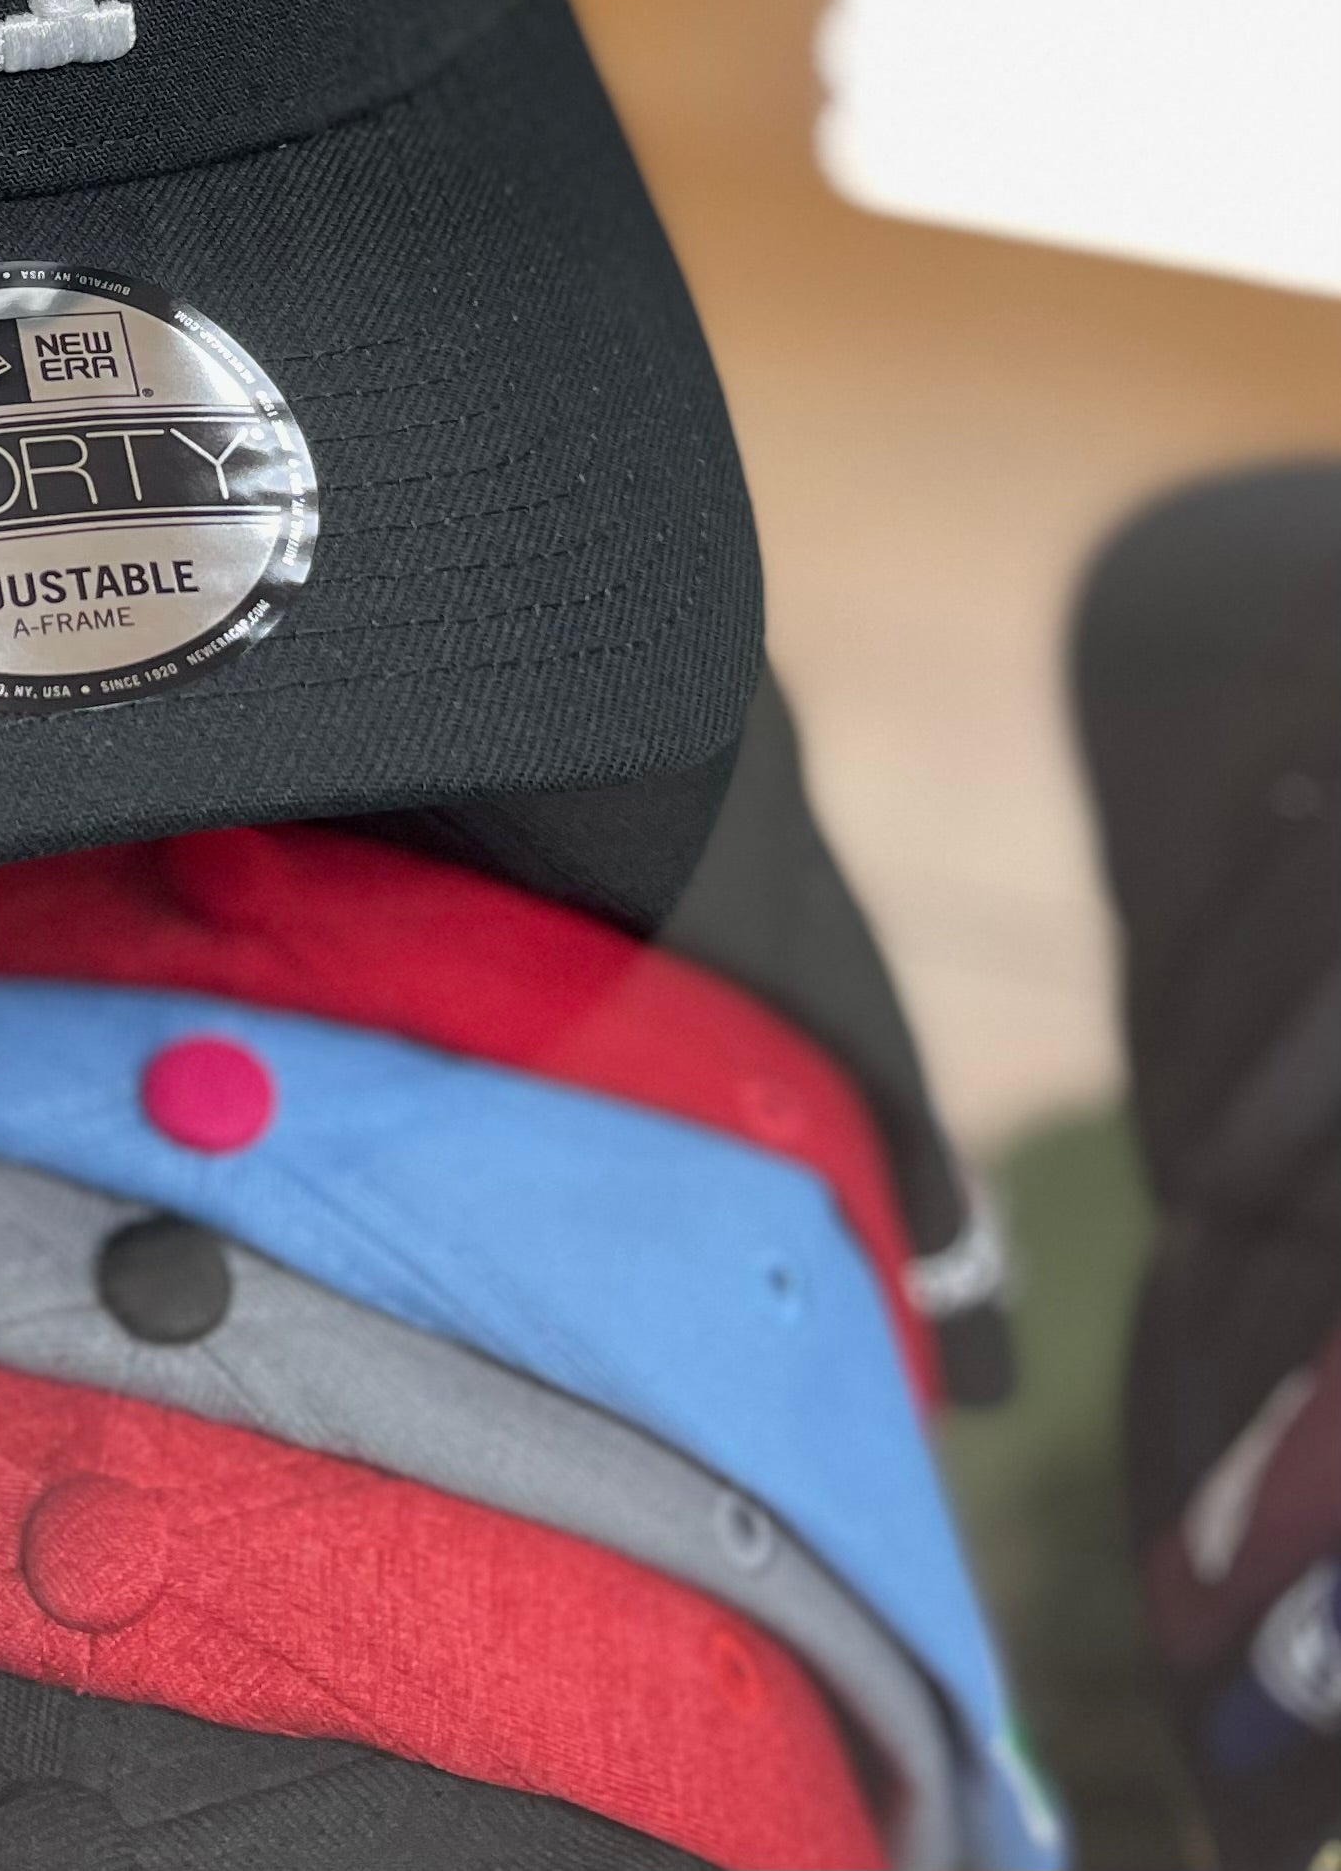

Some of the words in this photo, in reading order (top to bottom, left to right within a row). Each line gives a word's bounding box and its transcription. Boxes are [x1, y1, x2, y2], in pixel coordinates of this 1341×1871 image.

[20, 269, 46, 280] USA
[34, 331, 112, 358] NEW
[39, 356, 119, 382] ERA
[13, 606, 136, 639] A-FRAME
[42, 684, 72, 698] USA
[99, 673, 142, 694] SINCE
[144, 662, 179, 683] 1920
